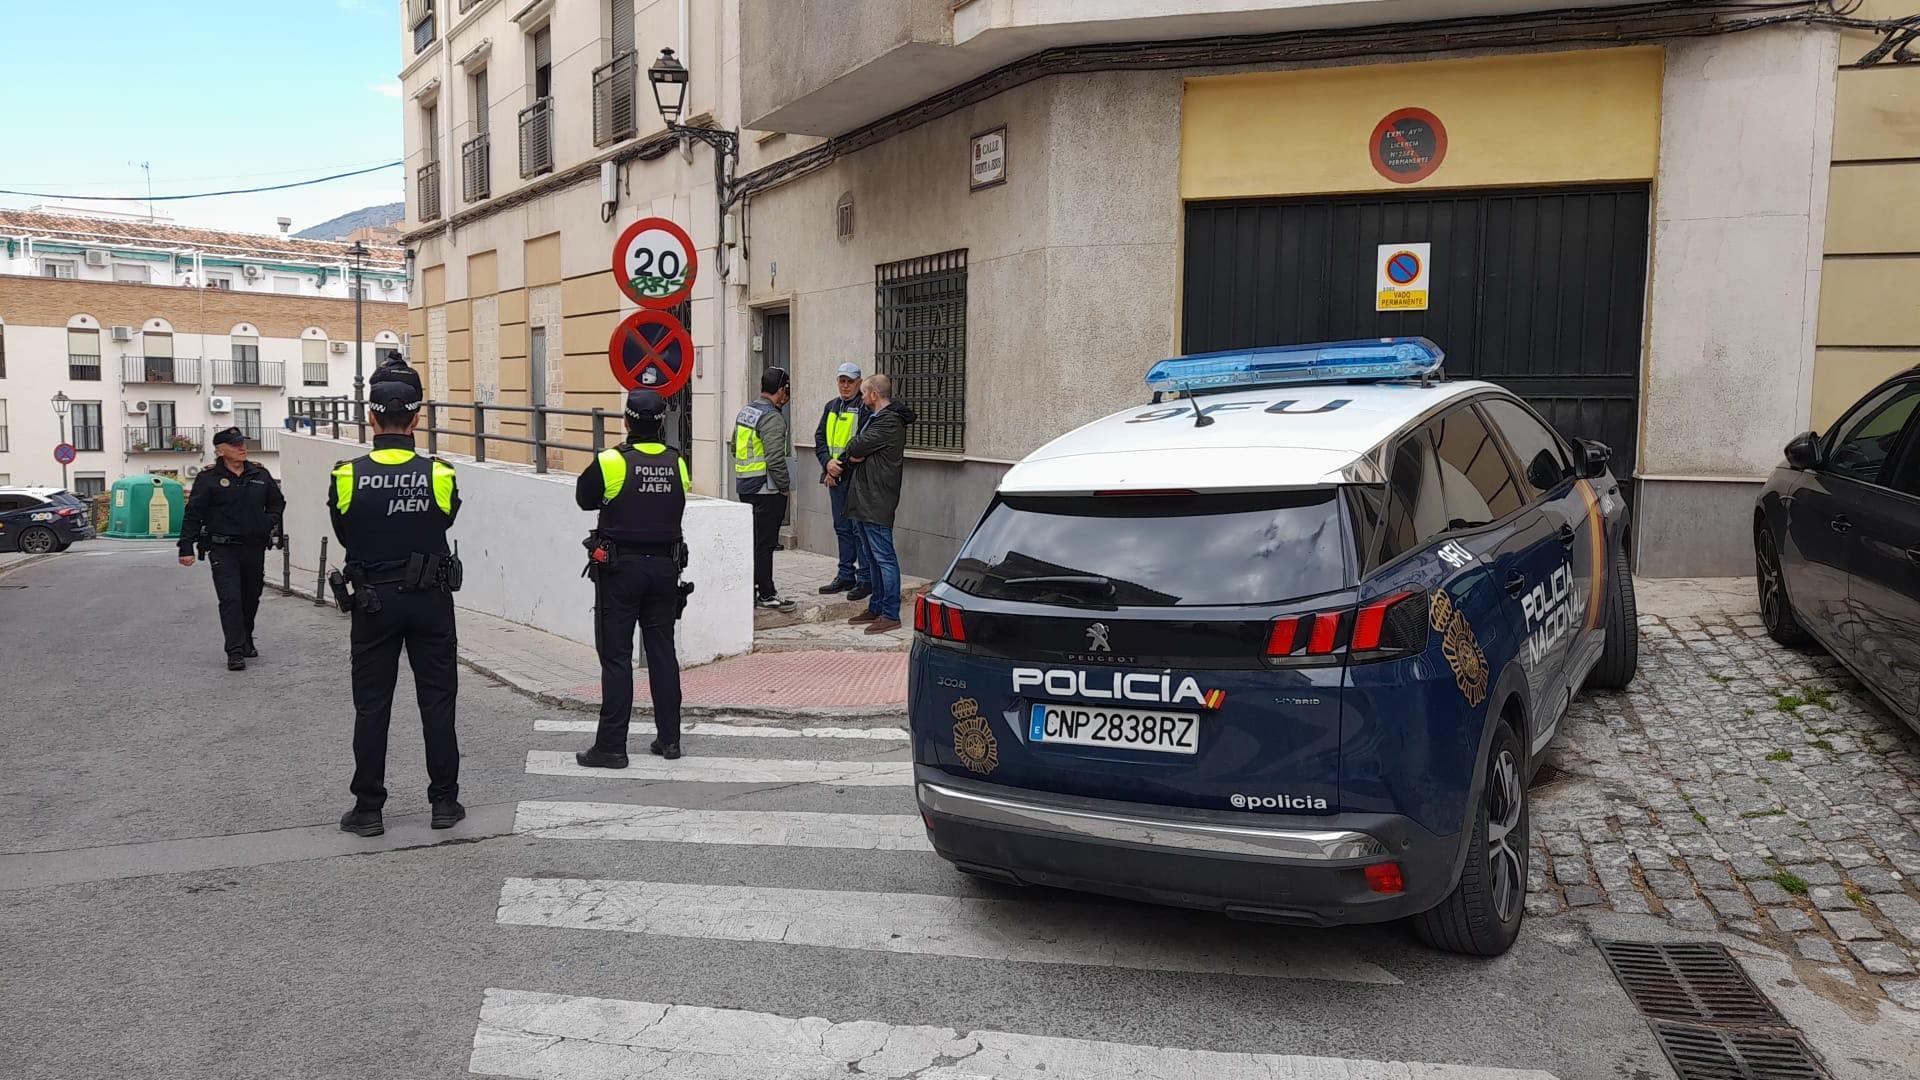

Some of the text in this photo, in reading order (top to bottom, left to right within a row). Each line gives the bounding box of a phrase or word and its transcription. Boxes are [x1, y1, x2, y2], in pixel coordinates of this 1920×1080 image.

[982, 140, 1000, 155] CALLE
[634, 247, 680, 280] 20
[1381, 298, 1424, 306] PERMANENTE
[1393, 291, 1411, 299] VADO
[1125, 399, 1354, 424] 9FU
[635, 465, 674, 476] POLICIA
[358, 471, 429, 490] POLICÍA
[638, 483, 672, 493] JAEN
[397, 487, 429, 497] LOCAL
[386, 496, 430, 516] JAÉN
[1437, 540, 1473, 568] 9FU
[1528, 586, 1585, 673] NACIONAL
[1068, 654, 1136, 664] PEUGEOT
[1012, 667, 1207, 705] POLICÍA
[1044, 709, 1194, 748] CNP2838RZ
[1230, 793, 1328, 810] @policia
